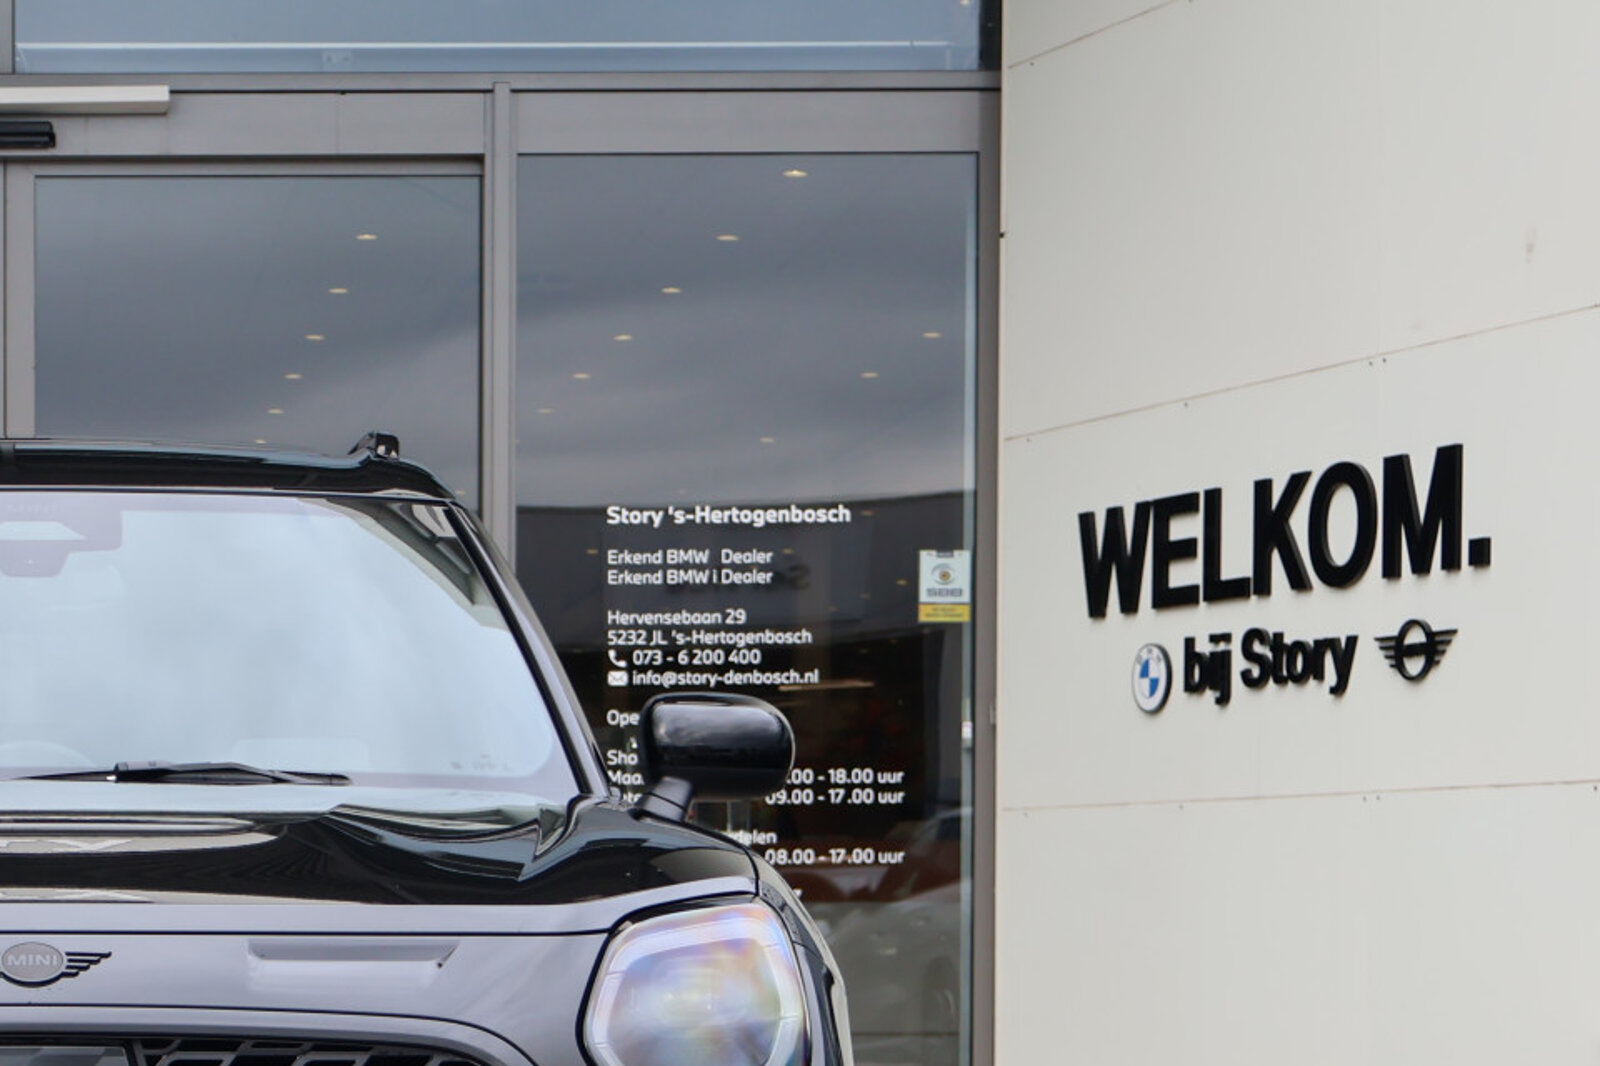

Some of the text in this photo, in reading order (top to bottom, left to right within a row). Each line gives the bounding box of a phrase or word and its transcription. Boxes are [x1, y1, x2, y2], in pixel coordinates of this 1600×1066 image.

[606, 507, 663, 527] Story
[1078, 443, 1491, 619] WELKOM.
[607, 549, 773, 564] Erkend BMW Dealer
[607, 569, 773, 584] Erkend BMW i Dealer
[607, 609, 746, 625] Hervensebaan 29
[607, 630, 646, 645] 5232
[649, 630, 667, 646] JL
[632, 650, 663, 665] 073
[678, 650, 688, 665] 6
[692, 650, 724, 664] 200
[728, 649, 762, 664] 400
[1183, 627, 1358, 705] bij Story
[632, 669, 819, 687] info@story-denbosch.nl
[606, 709, 640, 728] Ope
[606, 750, 638, 765] Sho
[828, 768, 874, 784] 18.00
[877, 771, 905, 784] uur
[877, 791, 905, 804] uur
[765, 849, 815, 865] 08.00
[878, 851, 905, 864] uur
[7, 954, 58, 966] MINI
